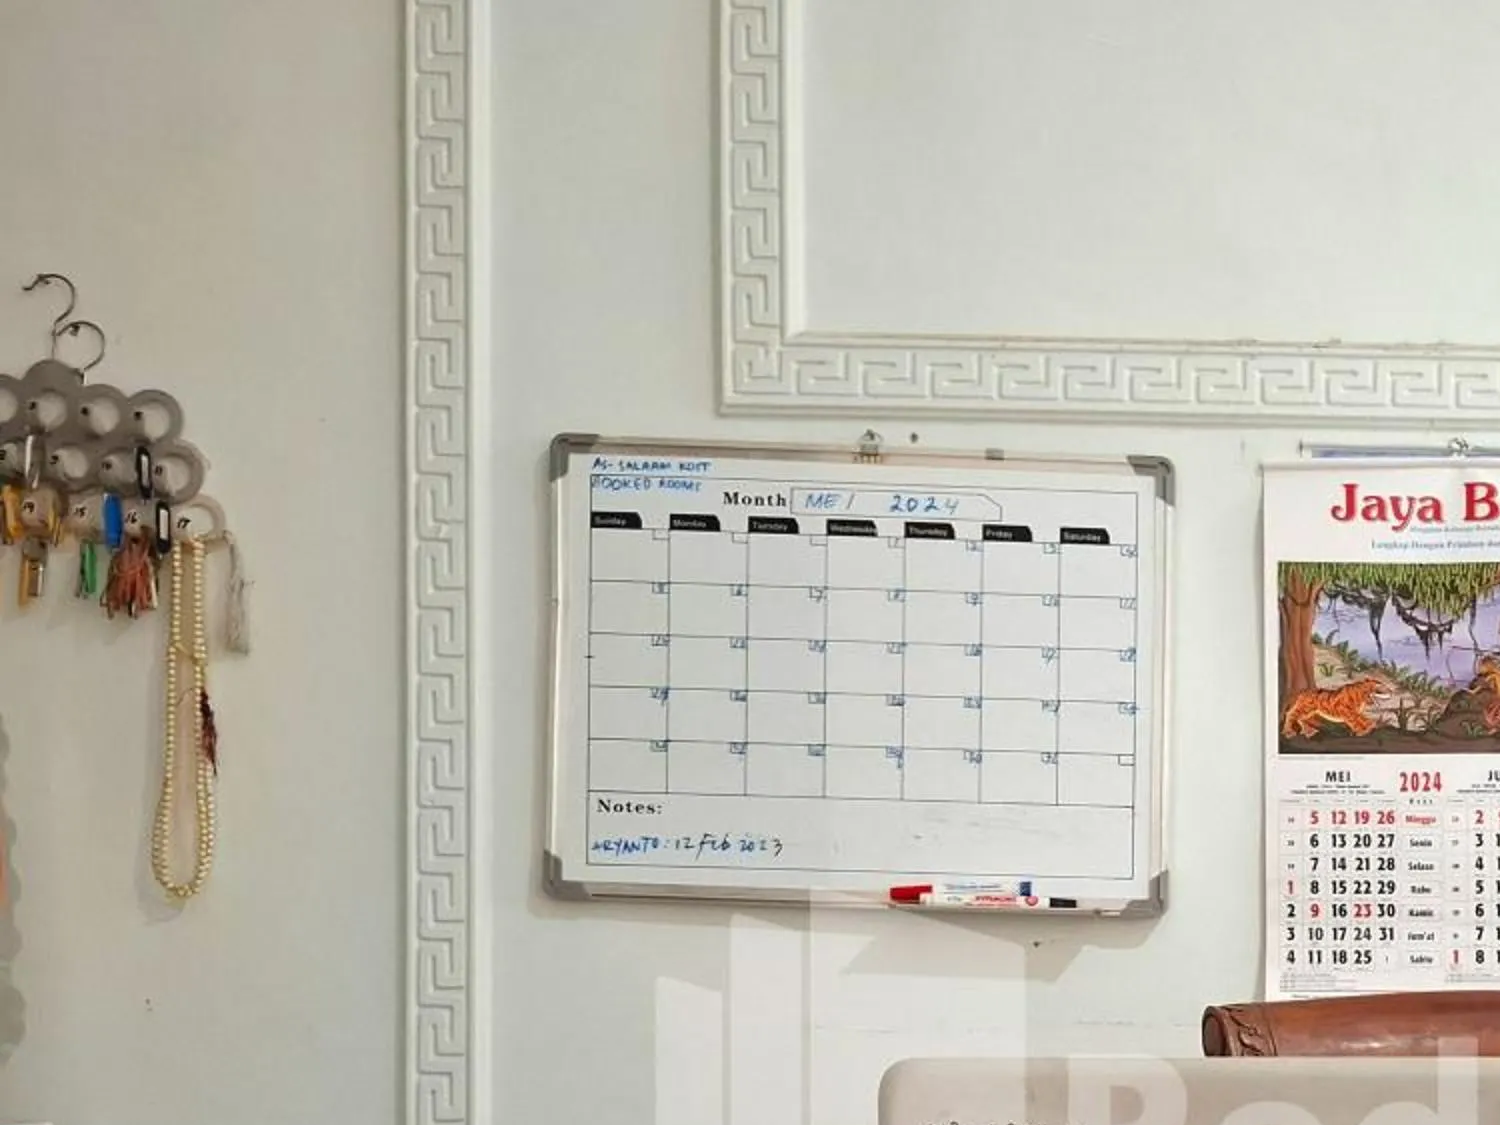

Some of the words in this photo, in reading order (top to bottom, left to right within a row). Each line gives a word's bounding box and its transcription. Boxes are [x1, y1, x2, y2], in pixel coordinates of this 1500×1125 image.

[723, 491, 787, 507] Month
[889, 494, 959, 514] 2024
[1331, 483, 1445, 532] Jaya
[1325, 771, 1351, 783] MEI
[1400, 772, 1442, 792] 2024
[596, 799, 663, 815] Notes:
[1310, 810, 1319, 824] 5
[1331, 810, 1347, 824] 12
[1354, 810, 1370, 824] 19
[1377, 810, 1395, 824] 26
[1475, 810, 1484, 824] 2
[1310, 834, 1319, 848] 6
[1331, 834, 1347, 848] 13
[1353, 834, 1372, 848] 20
[1377, 834, 1395, 848] 27
[1475, 833, 1484, 847] 3
[1310, 857, 1319, 871] 7
[1331, 857, 1347, 871] 14
[1356, 857, 1371, 871] 21
[1377, 857, 1395, 871] 28
[1475, 856, 1484, 870] 4
[1287, 880, 1294, 894] 1
[1310, 880, 1319, 894] 8
[1331, 880, 1347, 894] 15
[1353, 880, 1372, 894] 22
[1377, 880, 1396, 894] 29
[1475, 880, 1484, 894] 5
[1287, 904, 1296, 917] 2
[1311, 904, 1320, 917] 9
[1332, 904, 1348, 917] 16
[1353, 904, 1372, 917] 23
[1377, 904, 1396, 917] 30
[1475, 903, 1485, 917] 6
[1286, 927, 1295, 940] 3
[1308, 927, 1324, 940] 10
[1332, 927, 1347, 940] 17
[1353, 927, 1372, 940] 24
[1379, 927, 1395, 940] 31
[1476, 926, 1484, 940] 7
[1286, 950, 1296, 964] 4
[1308, 950, 1322, 964] 11
[1332, 950, 1348, 964] 18
[1354, 950, 1372, 964] 25
[1454, 950, 1459, 963] 1
[1475, 950, 1485, 963] 8
